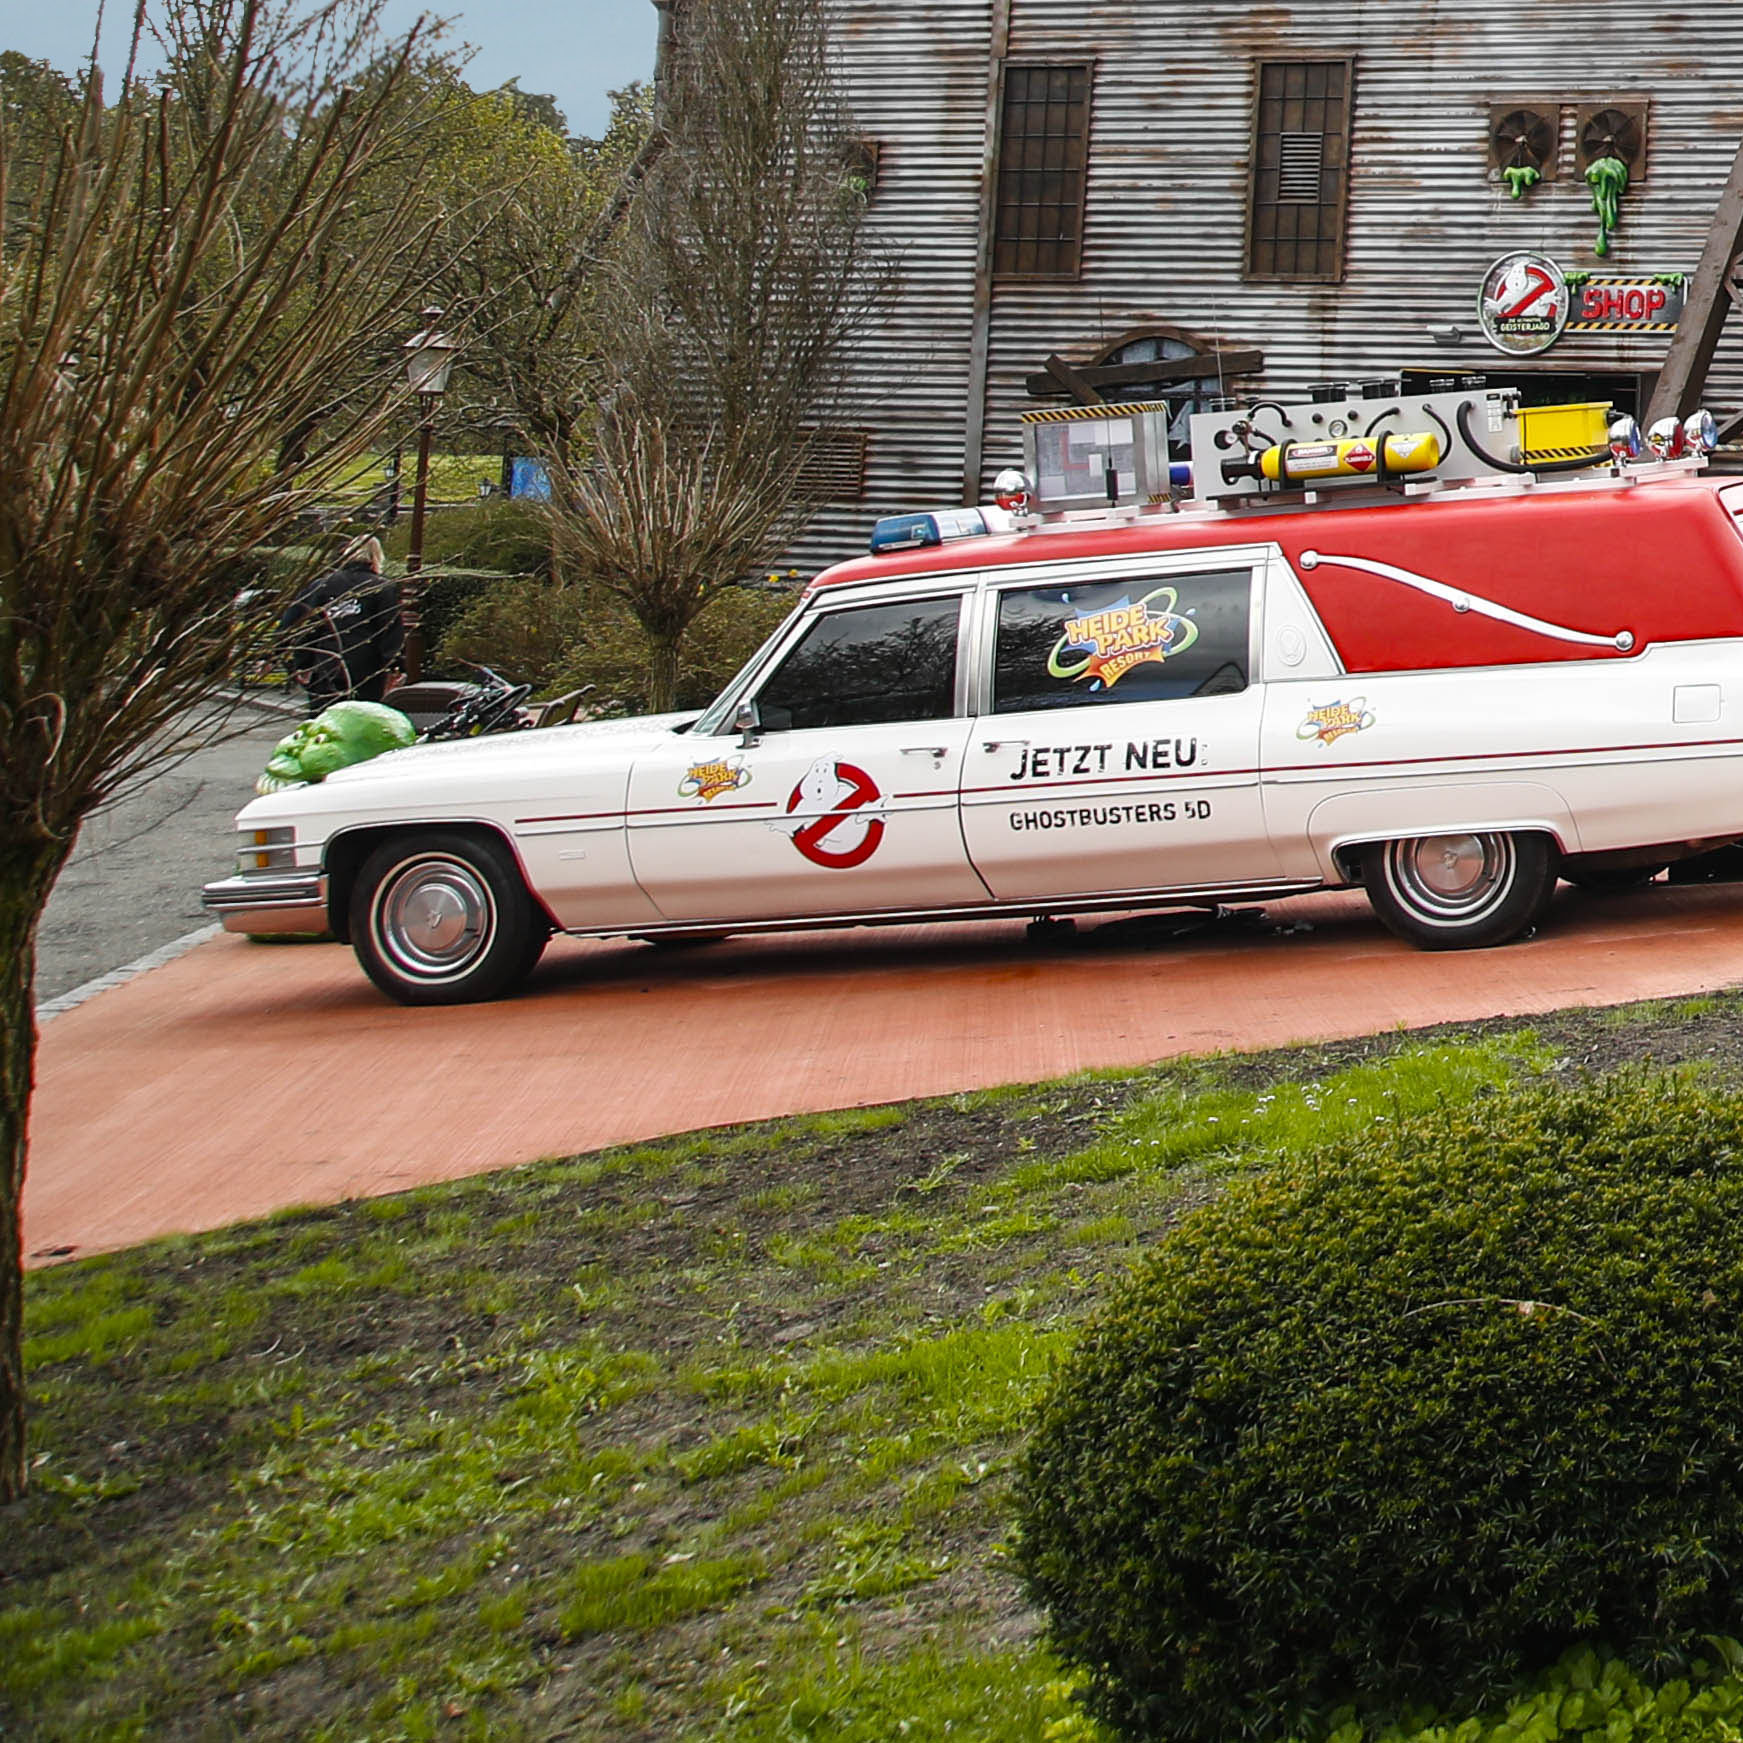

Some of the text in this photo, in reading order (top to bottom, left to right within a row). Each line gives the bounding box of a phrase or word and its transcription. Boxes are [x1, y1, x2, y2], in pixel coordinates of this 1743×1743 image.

[1582, 289, 1666, 320] SHOP
[1500, 322, 1550, 332] GEISTERJAGD
[1067, 603, 1147, 645] HEIDE
[1097, 617, 1174, 658] PARK
[1102, 651, 1152, 680] RESORT
[688, 760, 728, 779] HEIDE
[703, 768, 738, 786] PARK
[1010, 744, 1112, 780] JETZT
[1010, 800, 1211, 830] GHOSTBUSTERS 5D
